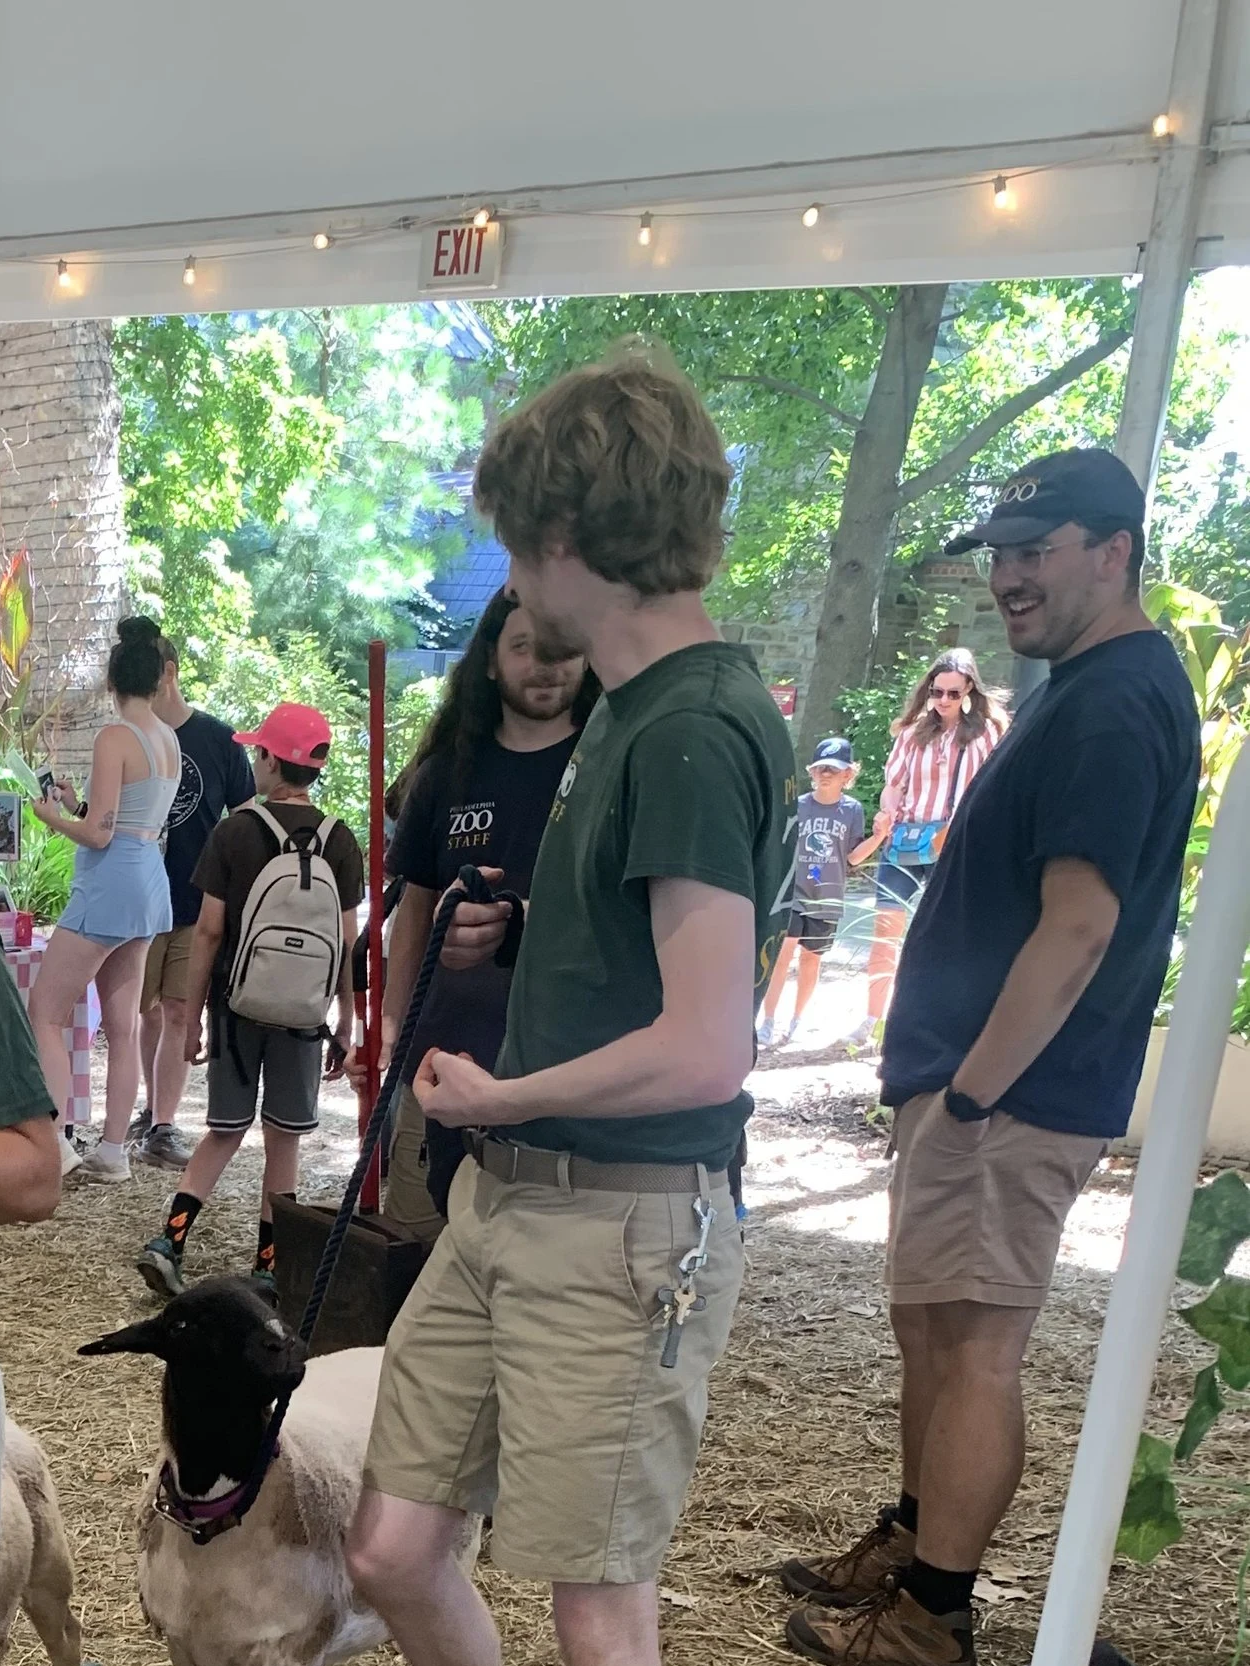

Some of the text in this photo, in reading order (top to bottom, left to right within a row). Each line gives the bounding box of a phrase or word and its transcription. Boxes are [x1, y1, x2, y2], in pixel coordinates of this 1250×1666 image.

[433, 227, 488, 277] EXIT
[449, 809, 494, 835] ZOO
[448, 832, 491, 850] STAFF
